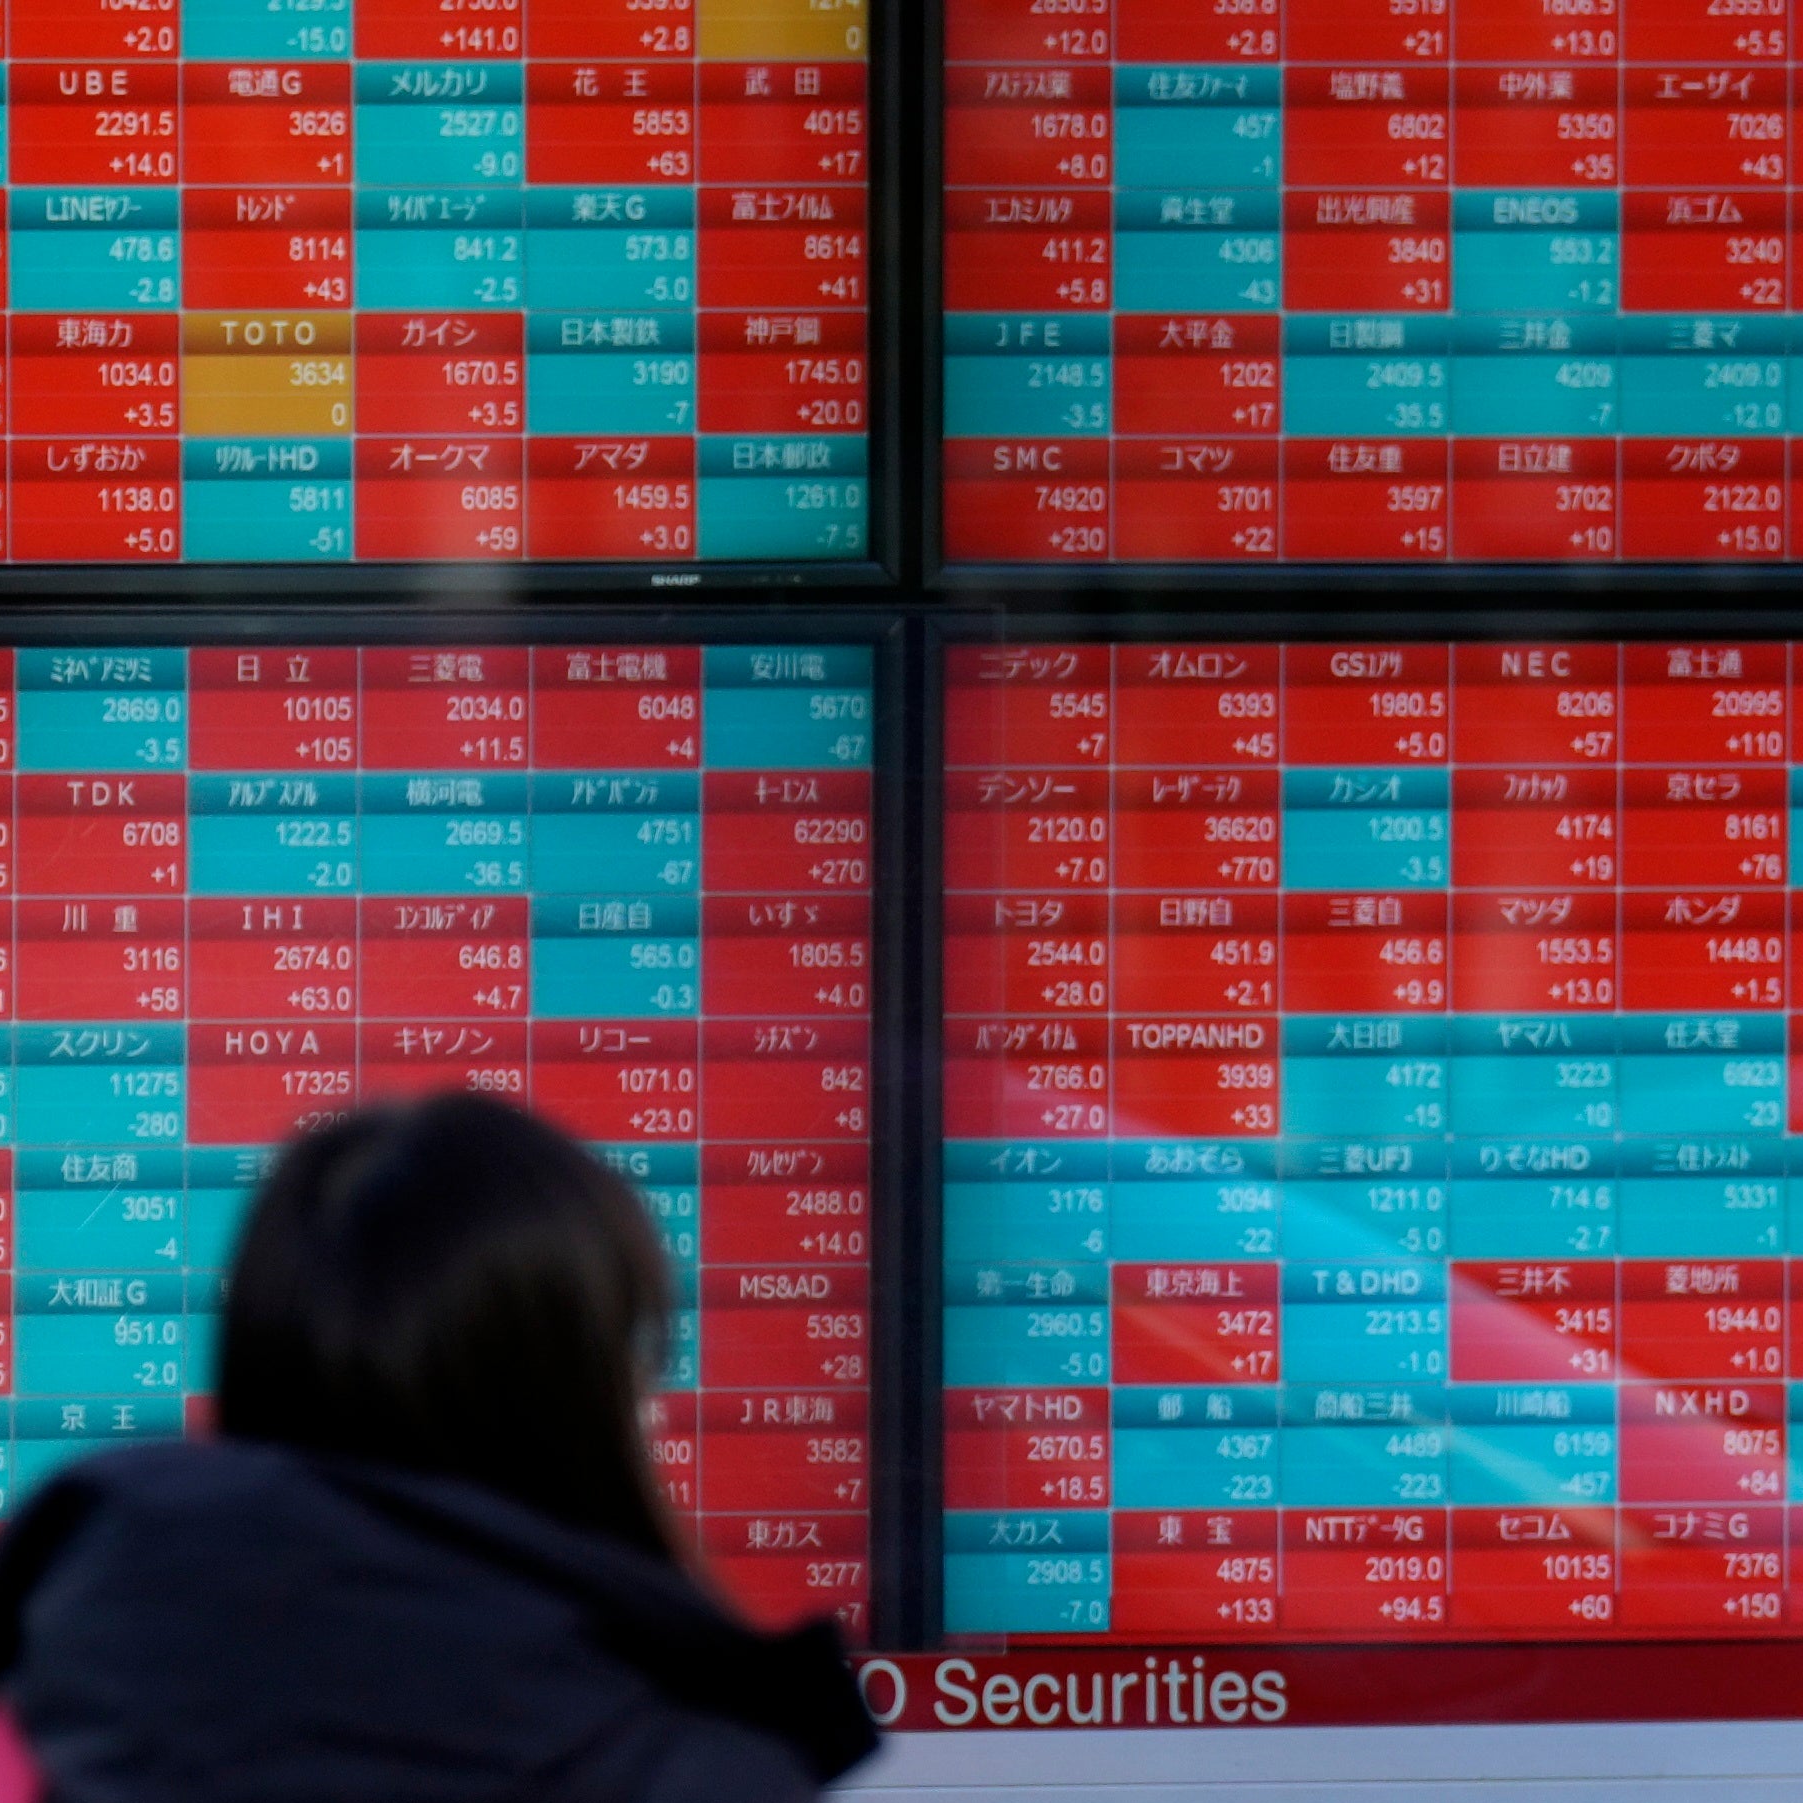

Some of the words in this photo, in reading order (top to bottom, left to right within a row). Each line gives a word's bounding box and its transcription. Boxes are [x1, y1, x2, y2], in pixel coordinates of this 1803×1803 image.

[439, 27, 519, 54] +141.0
[228, 67, 302, 97] 電通G
[391, 67, 487, 97] メルカリ
[95, 110, 175, 136] 2291.5
[289, 110, 347, 136] 3626
[633, 109, 691, 136] 5853
[803, 109, 861, 135] 4015
[109, 151, 175, 177] +14.0
[109, 236, 175, 262] 478.6
[289, 236, 347, 262] 8114
[1042, 237, 1107, 264] 411.2
[1726, 237, 1784, 264] 3240
[401, 317, 477, 347] ガイシ
[561, 317, 659, 346] 日本製鉄
[98, 361, 176, 387] 1034.0
[290, 360, 348, 386] 3634
[442, 360, 519, 386] 1670.5
[633, 359, 691, 386] 3190
[1220, 361, 1276, 388] 1202
[47, 443, 147, 472] しずおか
[390, 443, 491, 471] オークマ
[574, 441, 650, 470] アマダ
[98, 486, 176, 512] 1138.0
[289, 486, 345, 512] 5811
[460, 485, 519, 511] 6085
[614, 484, 691, 510] 1459.5
[1036, 486, 1106, 512] 74920
[1218, 485, 1273, 512] 3701
[1703, 484, 1782, 512] 2122.0
[1048, 526, 1107, 553] +230
[409, 652, 485, 682] 三菱電
[566, 651, 667, 682] 富士電機
[102, 696, 182, 723] 2869.0
[283, 696, 353, 722] 10105
[446, 695, 524, 722] 2034.0
[637, 694, 696, 721] 6048
[1049, 692, 1107, 719] 5545
[1218, 692, 1277, 718] 6393
[295, 736, 353, 763] +105
[459, 736, 524, 762] +11.5
[122, 821, 181, 847] 6708
[276, 820, 352, 848] 1222.5
[445, 820, 523, 846] 2669.5
[636, 818, 692, 845] 4751
[793, 818, 865, 844] 62290
[1028, 816, 1106, 843] 2120.0
[1205, 815, 1276, 842] 36620
[1218, 855, 1276, 882] +770
[123, 946, 181, 972] 3116
[273, 945, 353, 971] 2674.0
[458, 944, 523, 970] 646.8
[789, 942, 864, 968] 1805.5
[1027, 940, 1106, 966] 2544.0
[1210, 939, 1275, 966] 451.9
[1041, 980, 1106, 1007] +28.0
[49, 1029, 150, 1057] スクリン
[579, 1026, 651, 1053] リコー
[281, 1070, 351, 1096] 17325
[617, 1067, 694, 1093] 1071.0
[1027, 1064, 1105, 1092] 2766.0
[1217, 1062, 1276, 1089] 3939
[60, 1152, 138, 1183] 住友商
[122, 1195, 177, 1221] 3051
[786, 1190, 863, 1216] 2488.0
[739, 1273, 831, 1300] MS&AD
[806, 1314, 863, 1339] 5363
[1217, 1310, 1273, 1336] 3472
[806, 1437, 863, 1464] 3582
[1027, 1435, 1106, 1461] 2670.5
[746, 1519, 822, 1549] 東ガス
[1216, 1557, 1274, 1584] 4875
[1365, 1555, 1443, 1582] 2019.0
[1542, 1554, 1612, 1580] 10135
[1724, 1552, 1781, 1578] 7376
[1217, 1597, 1274, 1623] +133
[933, 1656, 1288, 1726] Securities
